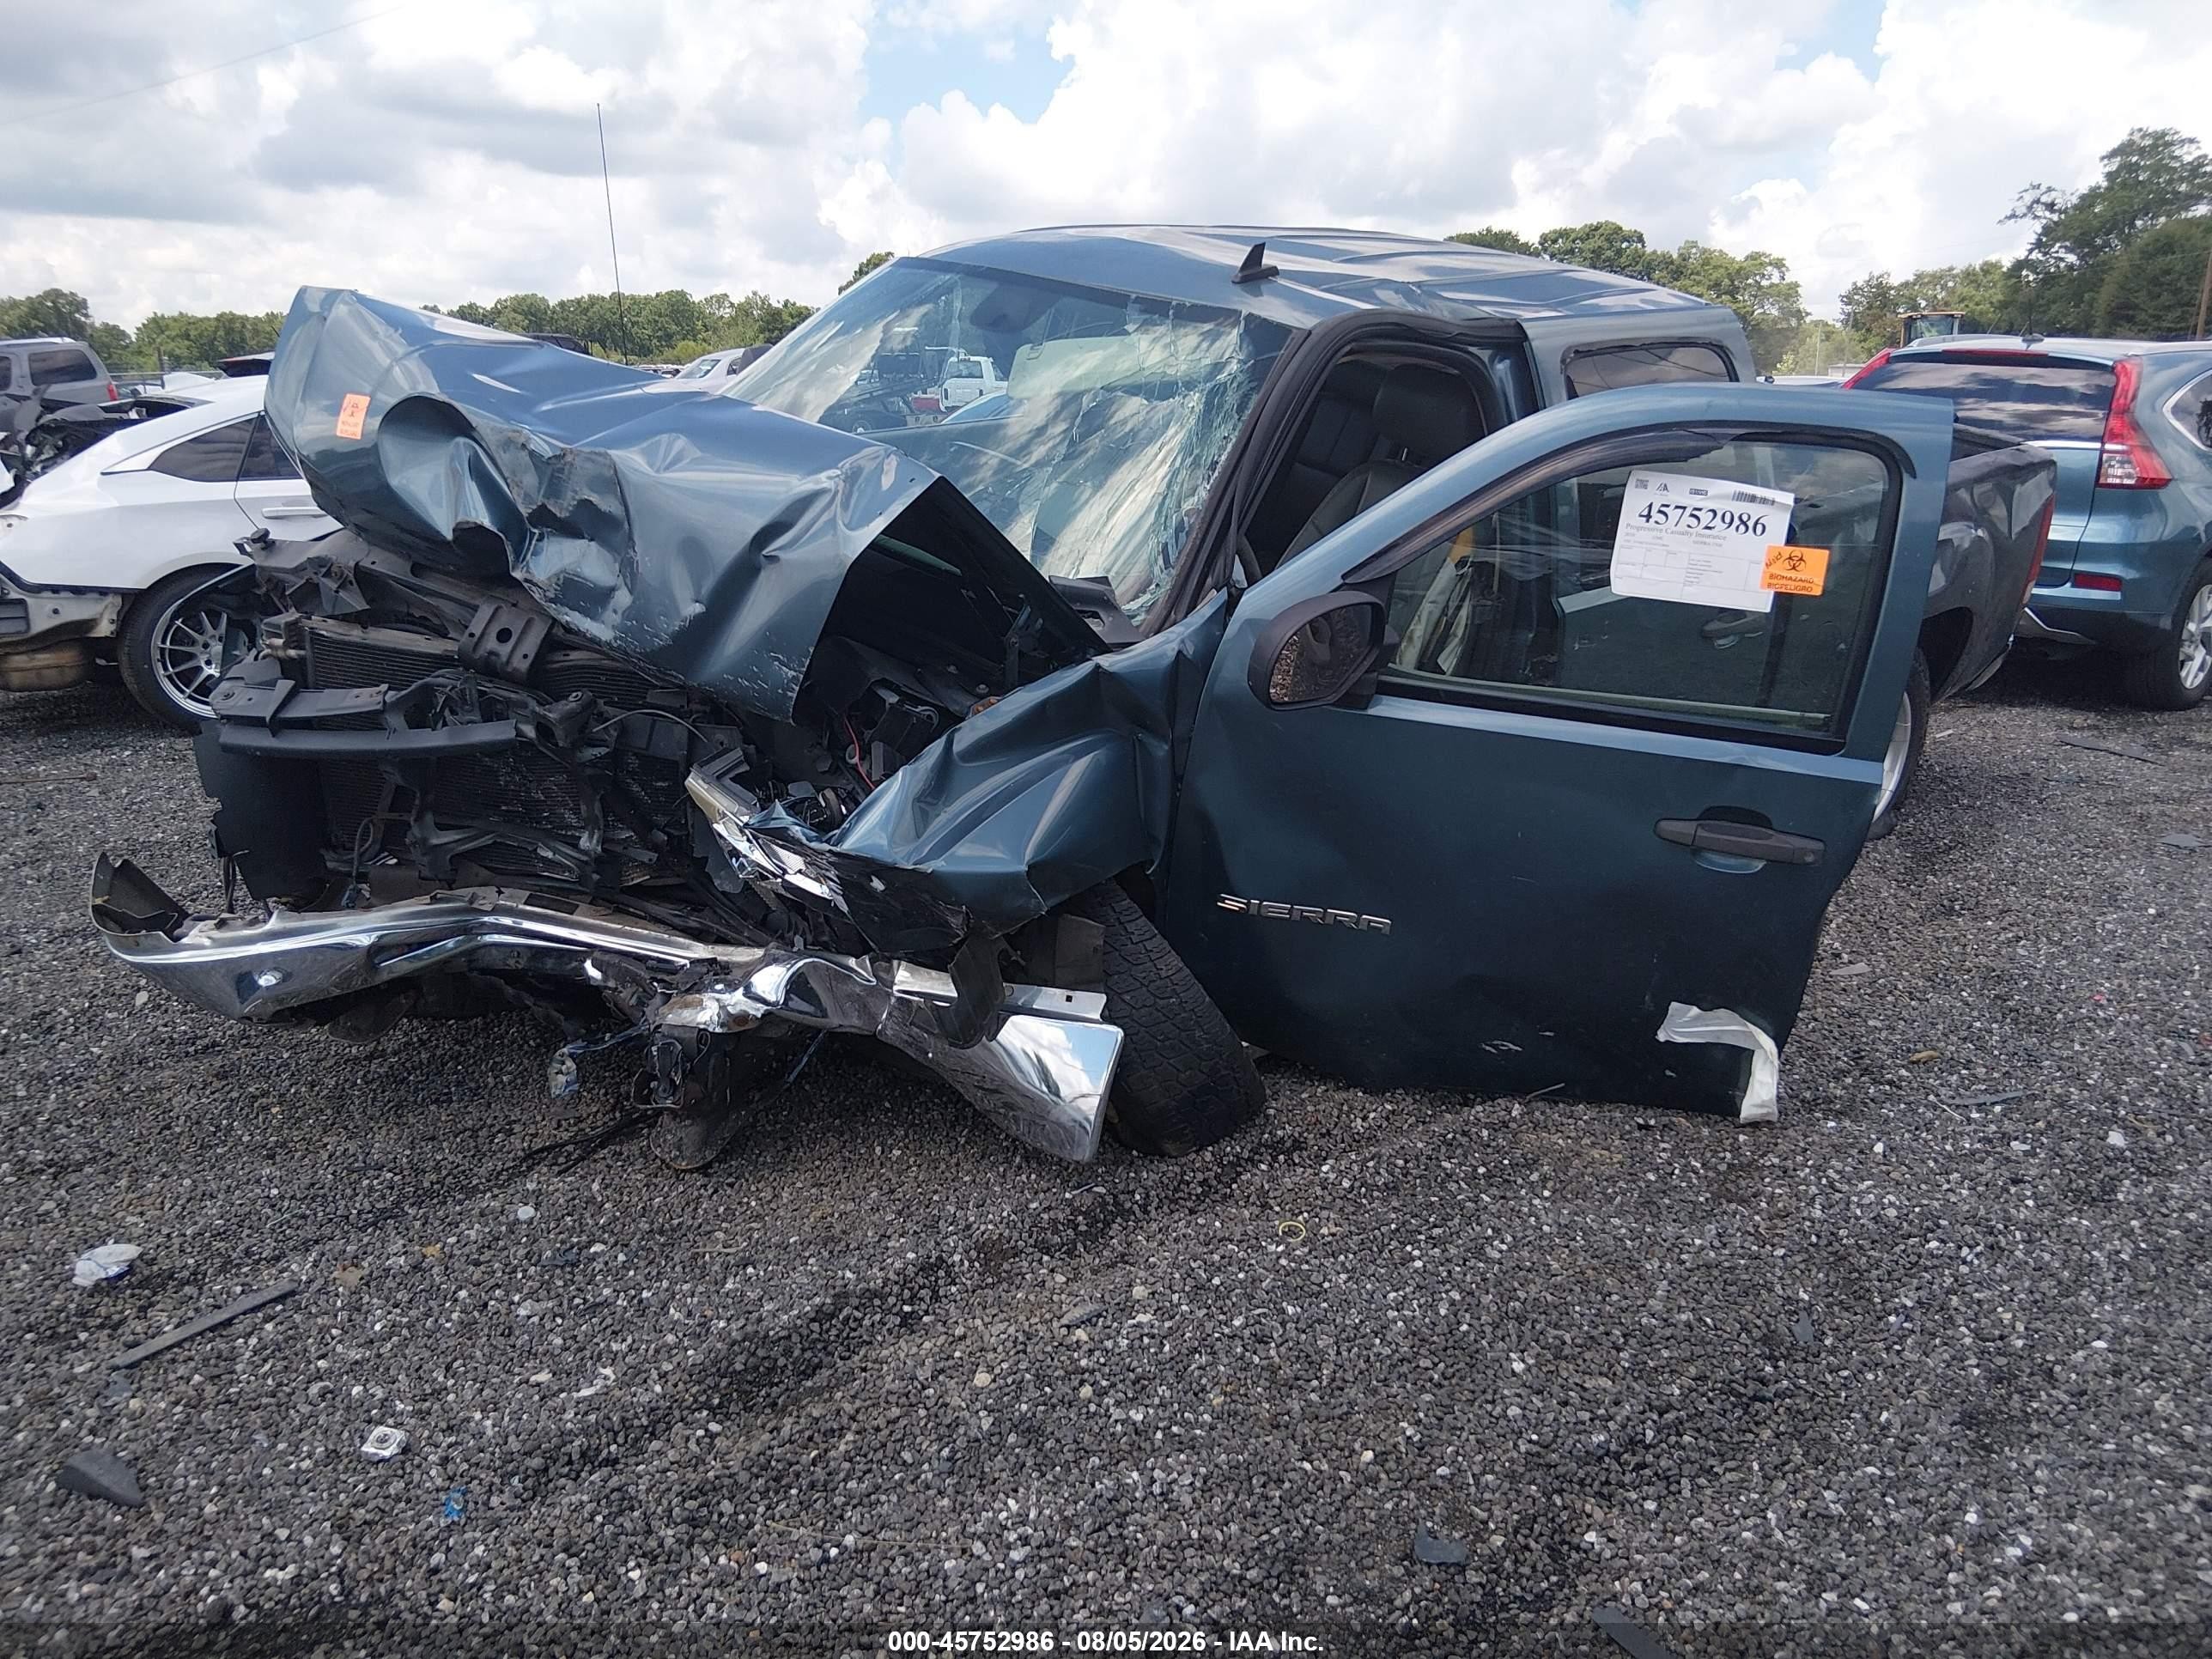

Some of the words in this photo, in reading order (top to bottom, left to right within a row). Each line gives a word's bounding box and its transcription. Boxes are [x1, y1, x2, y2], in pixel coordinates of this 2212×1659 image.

[1638, 501, 1771, 537] 45752986
[1626, 523, 1663, 534] Progressive
[1665, 527, 1693, 538] Casualty
[1695, 532, 1727, 542] Insurance
[1766, 582, 1814, 592] BIOPELIGRO
[1769, 573, 1814, 584] BIOHAZARD
[1217, 893, 1392, 935] SIERRA
